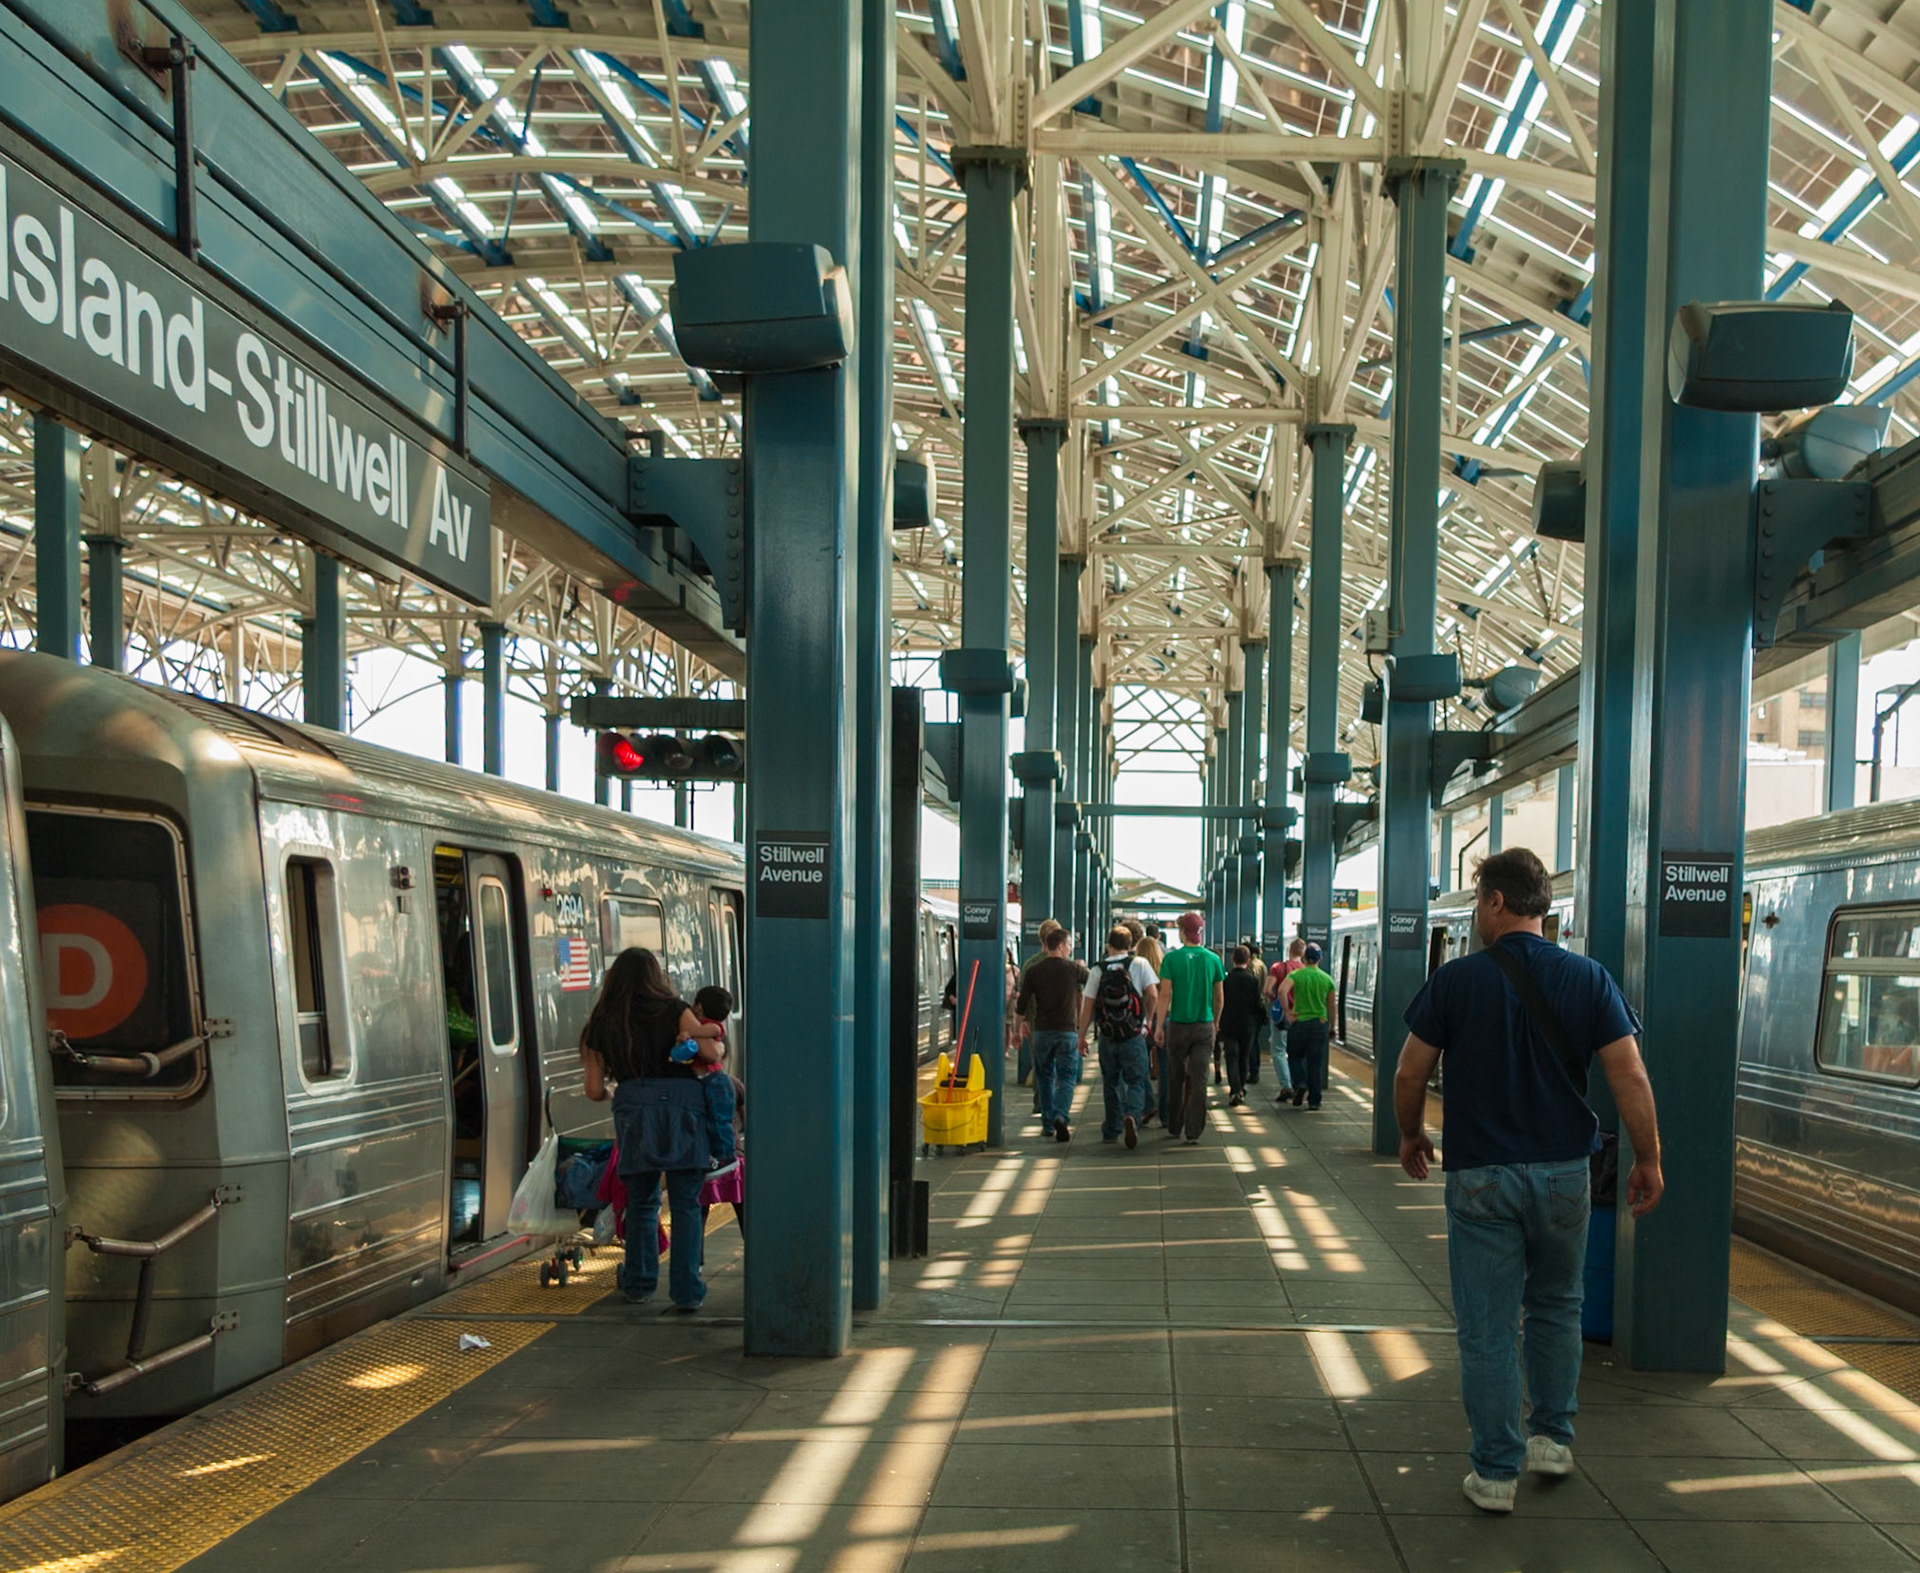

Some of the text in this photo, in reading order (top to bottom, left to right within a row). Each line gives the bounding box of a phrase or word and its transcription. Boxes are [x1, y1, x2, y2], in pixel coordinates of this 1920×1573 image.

[429, 466, 472, 563] Av
[760, 846, 824, 863] Stillwell
[760, 866, 823, 882] Avenue
[1665, 865, 1729, 883] Stillwell
[1665, 885, 1727, 902] Avenue
[556, 893, 584, 926] 2694
[964, 905, 992, 916] Coney
[964, 915, 989, 923] Island
[1390, 915, 1418, 925] Coney
[1390, 925, 1415, 933] Island
[41, 932, 113, 1010] D
